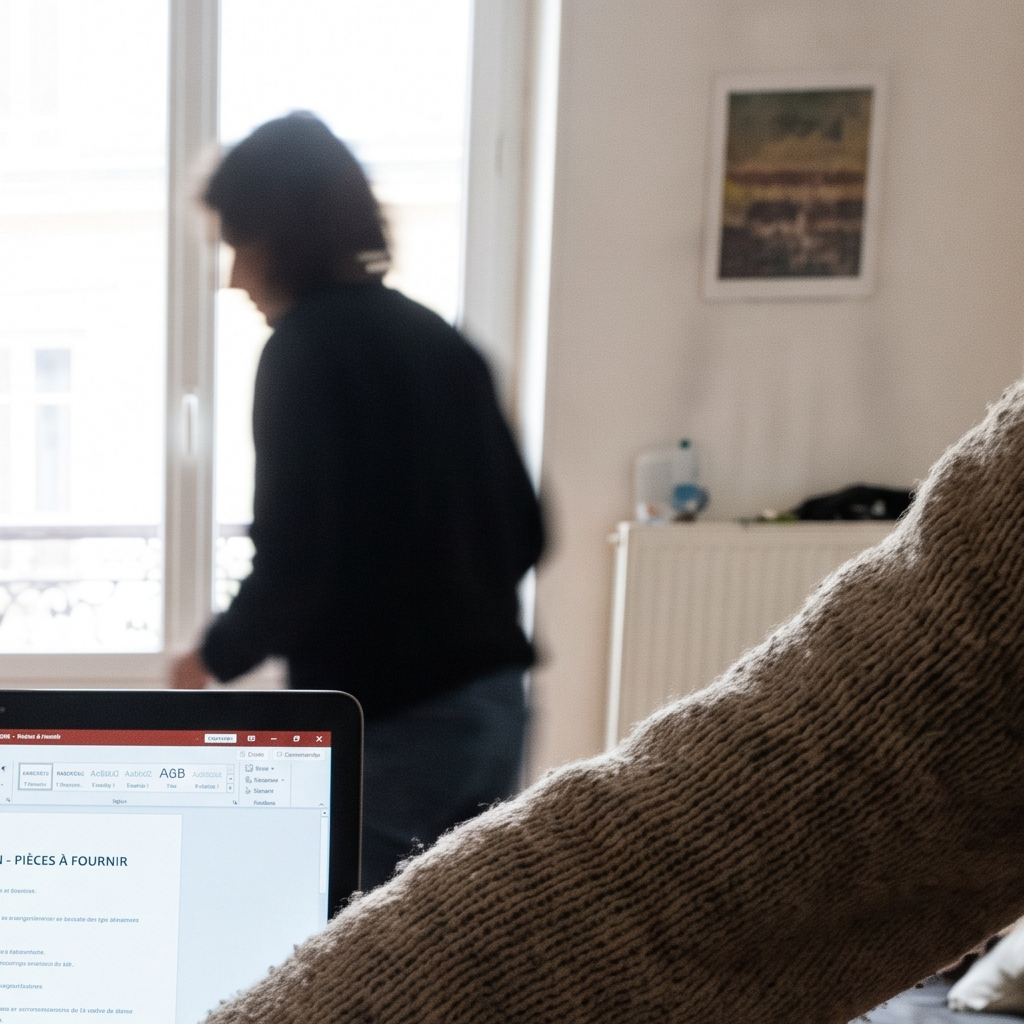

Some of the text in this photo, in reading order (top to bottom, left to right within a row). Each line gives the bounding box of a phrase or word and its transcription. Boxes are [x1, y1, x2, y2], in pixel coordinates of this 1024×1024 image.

[14, 852, 56, 866] PIÈCES
[59, 853, 68, 866] À
[71, 855, 128, 867] FOURNIR
